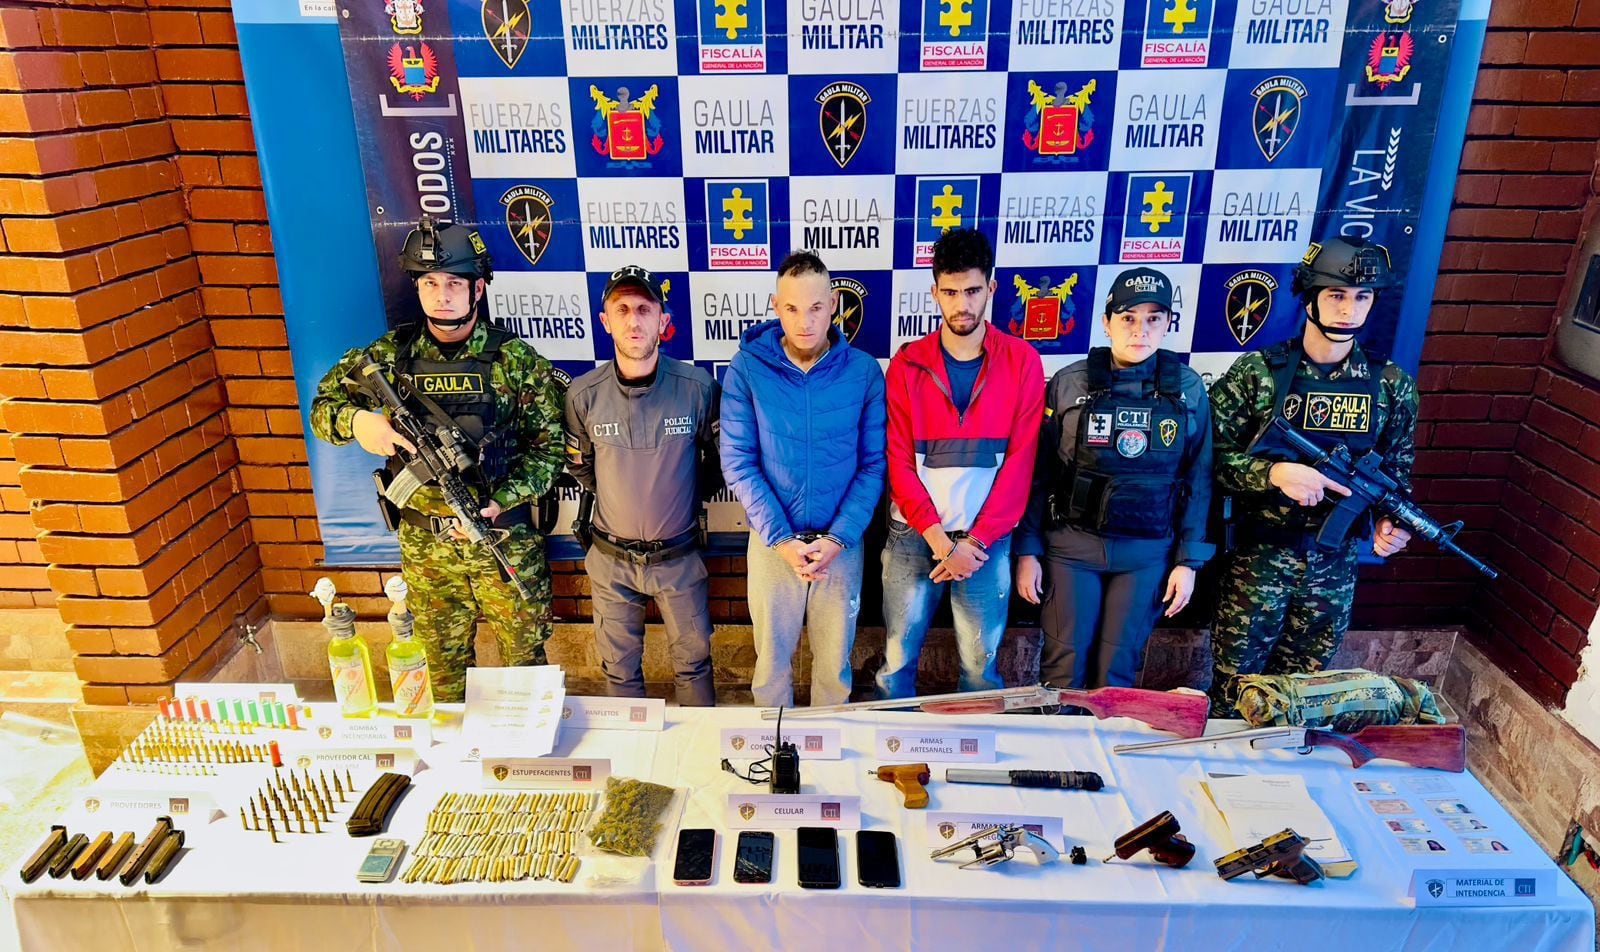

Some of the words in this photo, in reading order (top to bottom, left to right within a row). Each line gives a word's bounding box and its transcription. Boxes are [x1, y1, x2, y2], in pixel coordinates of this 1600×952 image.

[569, 0, 664, 22] FUERZAS
[802, 0, 884, 21] GAULA
[1019, 0, 1114, 19] FUERZAS
[571, 25, 668, 50] MILITARES
[803, 25, 884, 50] MILITAR
[1017, 19, 1114, 45] MILITARES
[1246, 19, 1328, 44] MILITAR
[702, 46, 763, 59] FISCALÍA
[923, 43, 984, 56] FISCALÍA
[1145, 40, 1206, 53] FISCALÍA
[819, 85, 840, 101] GAULA
[842, 85, 868, 102] MILITAR
[1255, 79, 1279, 96] GAULA
[1280, 78, 1305, 96] MILITAR
[470, 102, 562, 128] FUERZAS
[693, 99, 774, 127] GAULA
[904, 97, 996, 123] FUERZAS
[1129, 94, 1206, 121] GAULA
[473, 129, 566, 154] MILITARES
[695, 130, 774, 154] MILITAR
[903, 124, 996, 149] MILITARES
[1125, 124, 1204, 148] MILITAR
[1349, 149, 1386, 187] LA
[504, 188, 523, 204] GAULA
[524, 187, 551, 205] MILITAR
[1223, 191, 1302, 217] GAULA
[586, 201, 677, 224] FUERZAS
[803, 198, 880, 223] GAULA
[1006, 196, 1096, 219] FUERZAS
[590, 225, 680, 249] MILITARES
[804, 226, 880, 249] MILITAR
[1004, 219, 1095, 244] MILITARES
[1218, 219, 1299, 242] MILITAR
[710, 245, 768, 257] FISCALÍA
[1123, 238, 1182, 250] FISCALÍA
[611, 267, 651, 282] CTI
[1125, 275, 1165, 289] GAULA
[1228, 273, 1249, 288] GAULA
[1250, 272, 1275, 289] MILITAR
[840, 280, 865, 296] MILITAR
[494, 294, 582, 316] FUERZAS
[424, 376, 473, 392] GAULA
[1332, 396, 1367, 413] GAULA
[1118, 411, 1149, 424] CTI
[1331, 412, 1358, 429] ELITE
[1359, 413, 1367, 429] 2
[593, 422, 620, 437] CTI
[585, 709, 619, 717] PANFLETOS
[910, 746, 953, 754] ARTESANALES
[512, 769, 572, 777] ESTUPEFACIENTES
[110, 801, 162, 809] PROVEEDORES
[774, 807, 805, 815] CELULAR
[1455, 879, 1494, 887] MATERIAL
[1455, 889, 1506, 898] INTENDENCIA
